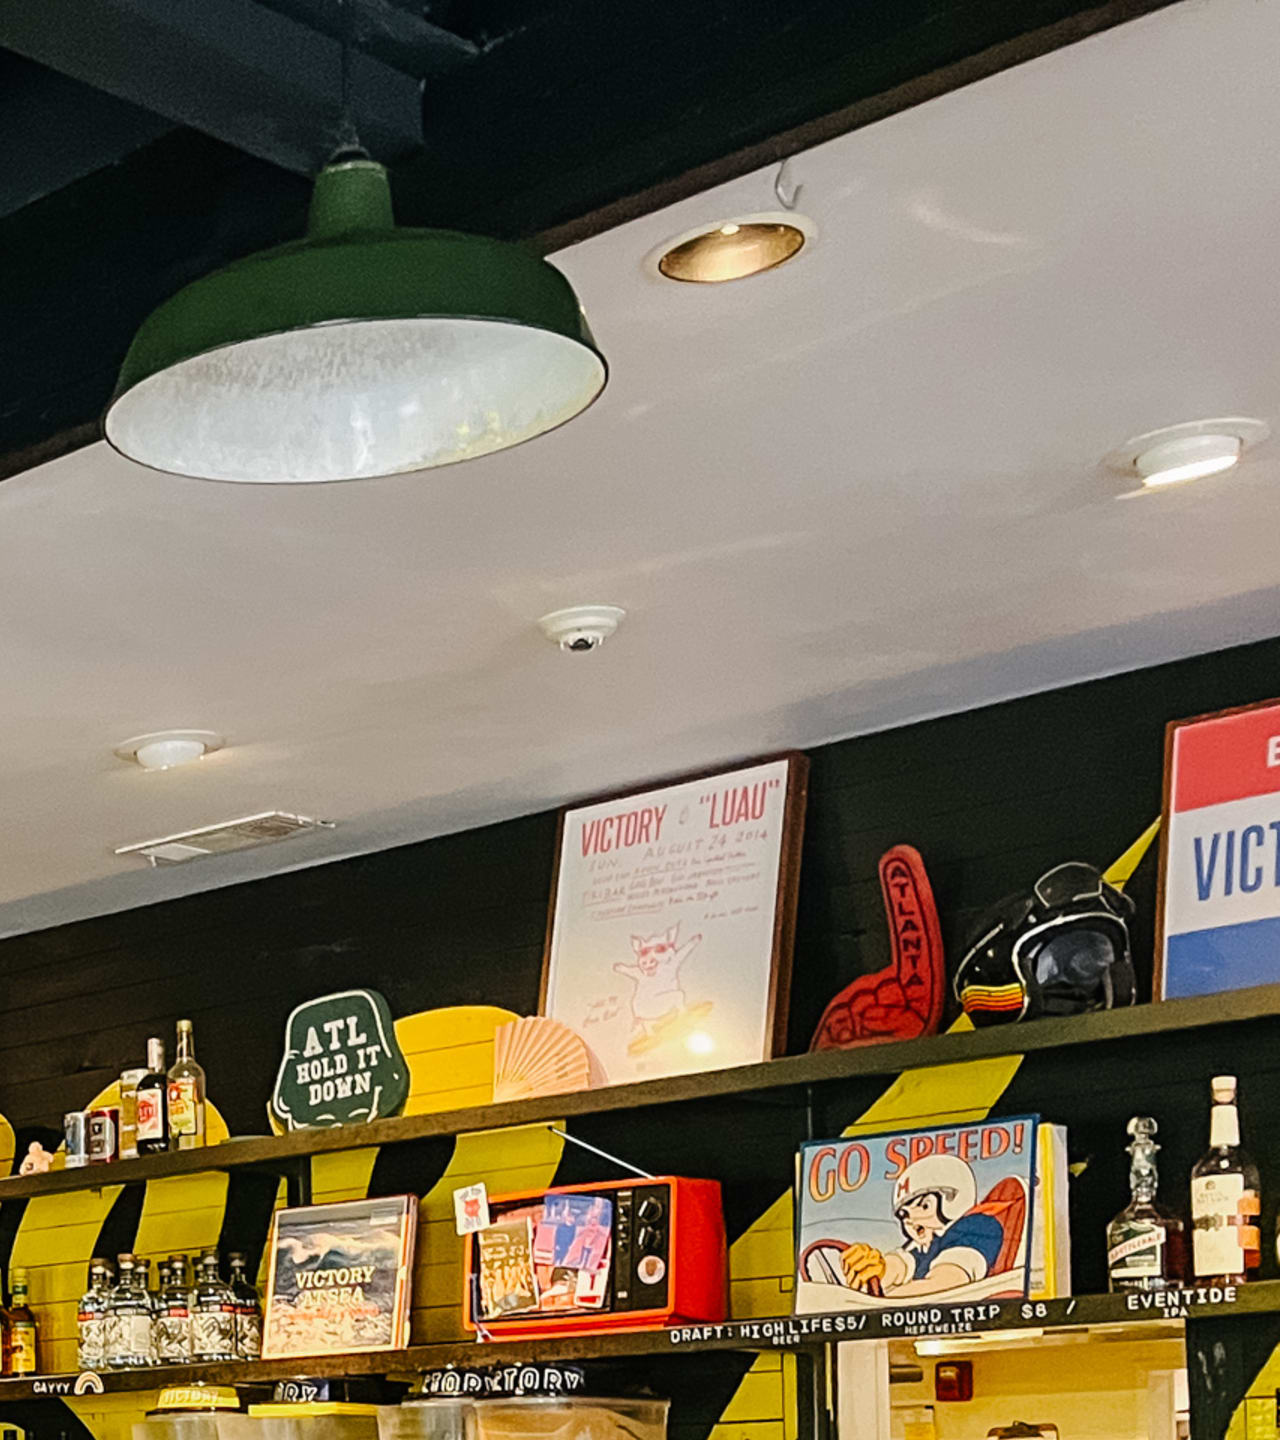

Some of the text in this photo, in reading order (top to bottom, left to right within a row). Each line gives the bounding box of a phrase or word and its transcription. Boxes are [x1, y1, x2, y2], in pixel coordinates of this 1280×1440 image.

[581, 778, 780, 857] VICTORY "LUAU"
[889, 865, 925, 987] ATLANTA
[302, 1015, 368, 1058] ATL
[296, 1045, 382, 1085] HOLD IT
[308, 1072, 373, 1106] DOWN
[808, 1123, 1024, 1202] GO SPEED!
[295, 1265, 376, 1289] VICTORY
[327, 1285, 366, 1304] SEA
[670, 1324, 733, 1344] DRAFT:
[881, 1306, 942, 1328] ROUND
[951, 1304, 1001, 1323] TRIP
[1127, 1286, 1237, 1310] EVENTIDE
[1163, 1306, 1190, 1318] IPA
